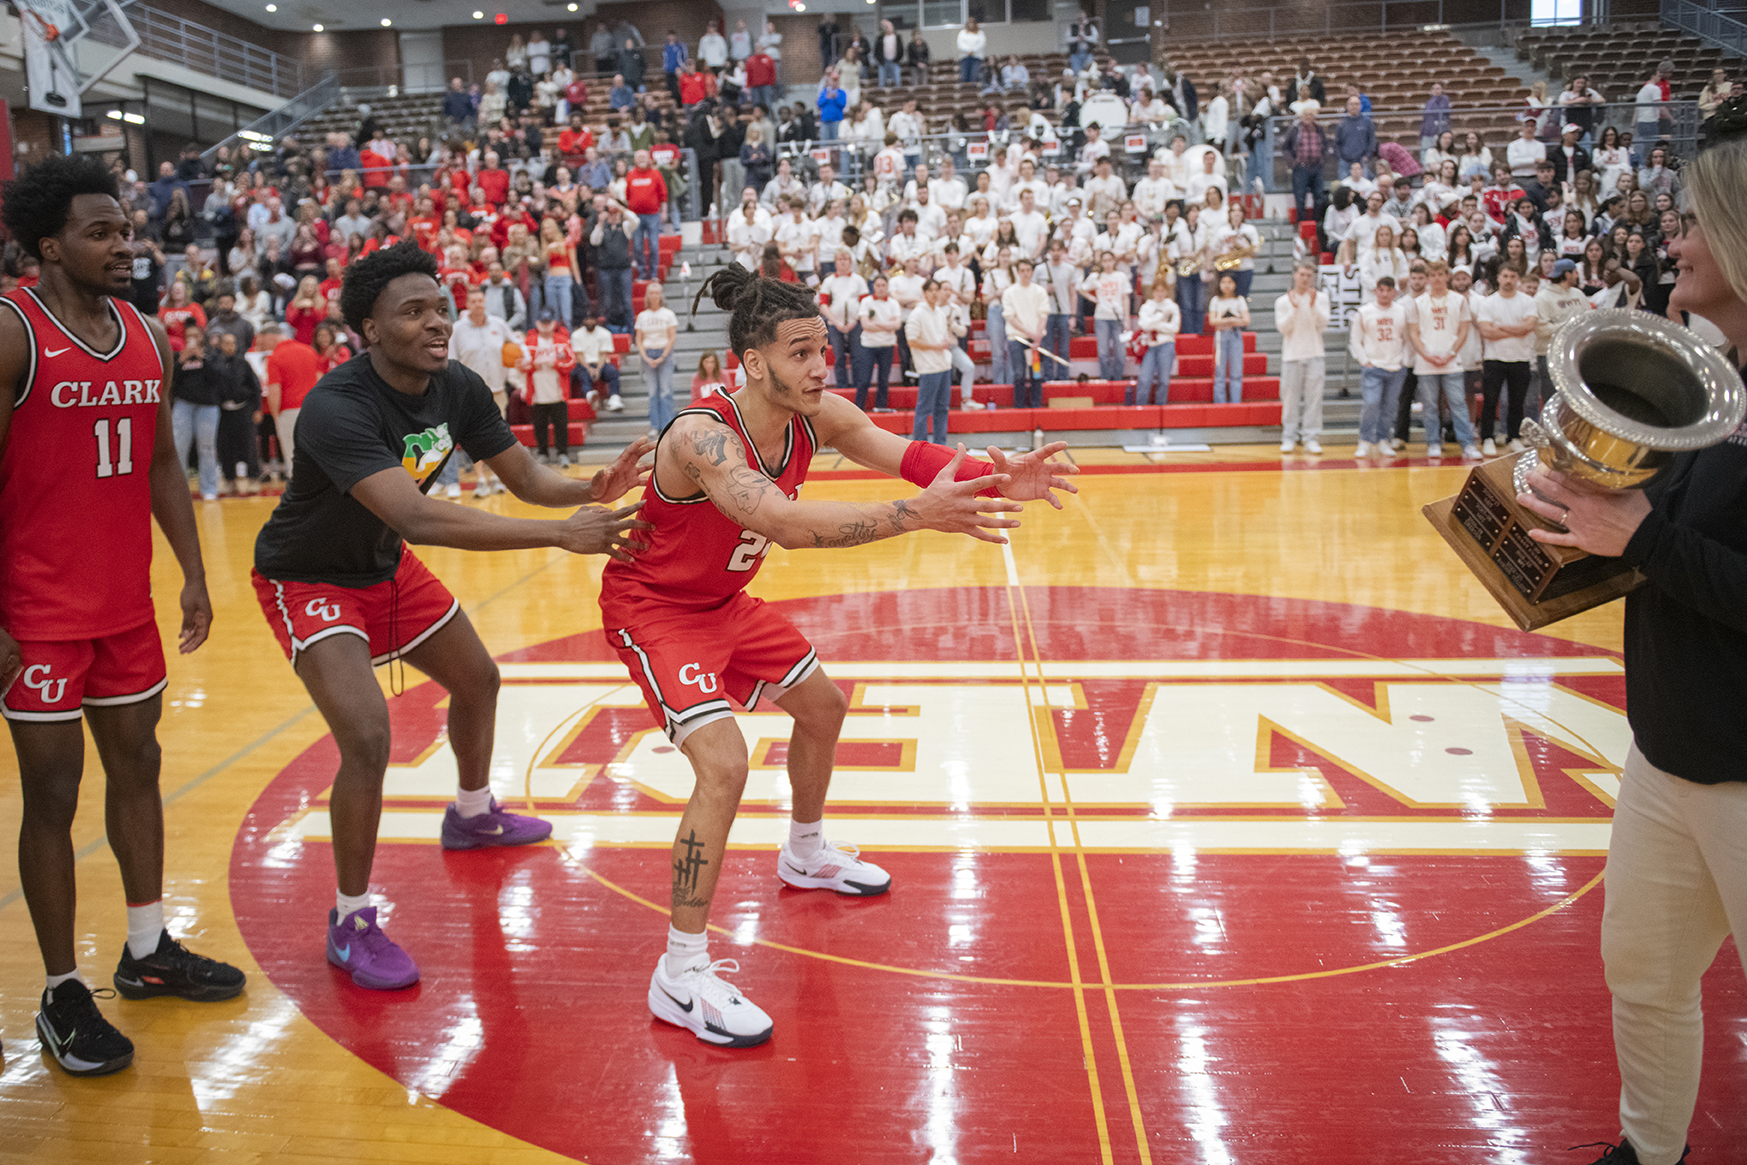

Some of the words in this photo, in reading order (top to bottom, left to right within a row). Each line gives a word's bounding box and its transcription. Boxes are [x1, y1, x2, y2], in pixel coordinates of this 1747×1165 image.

[1378, 328, 1393, 342] 32
[1434, 317, 1445, 331] 31
[51, 380, 161, 409] CLARK
[93, 417, 133, 479] 11
[304, 597, 341, 622] CU
[24, 664, 68, 704] CU
[679, 662, 718, 694] CU
